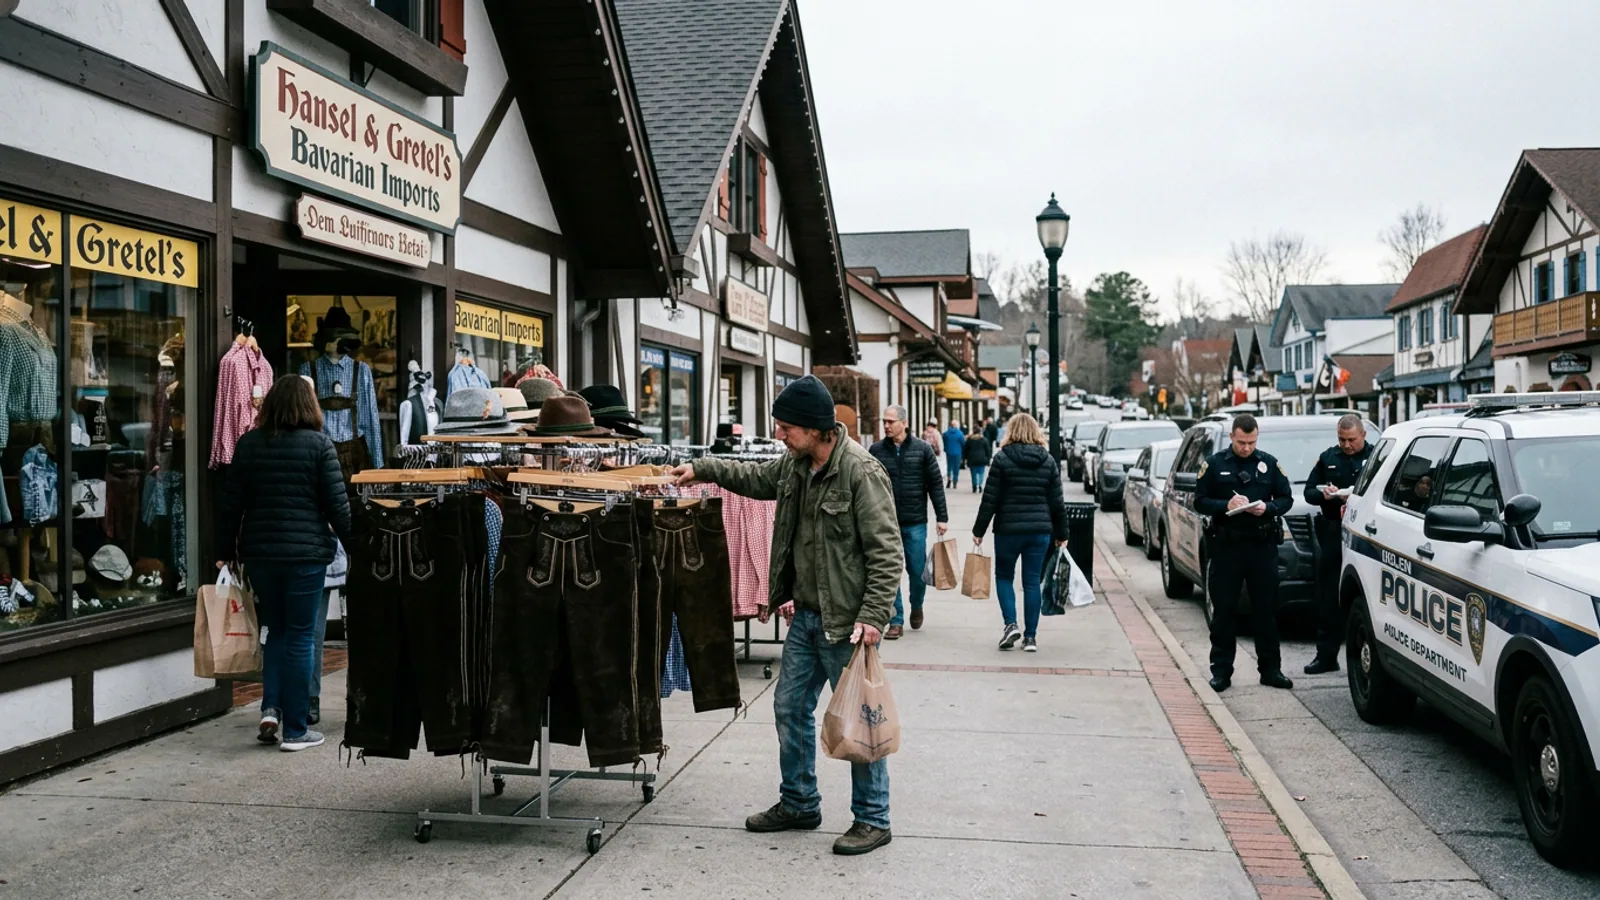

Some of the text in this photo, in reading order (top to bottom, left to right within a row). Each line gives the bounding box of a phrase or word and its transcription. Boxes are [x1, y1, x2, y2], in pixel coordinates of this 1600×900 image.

[277, 66, 452, 181] Hansel & Gretel's
[290, 125, 440, 213] Bavarian Imports
[29, 214, 54, 258] &
[77, 222, 186, 279] Gretel's
[455, 303, 500, 335] Bavarian
[1380, 568, 1463, 647] POLICE
